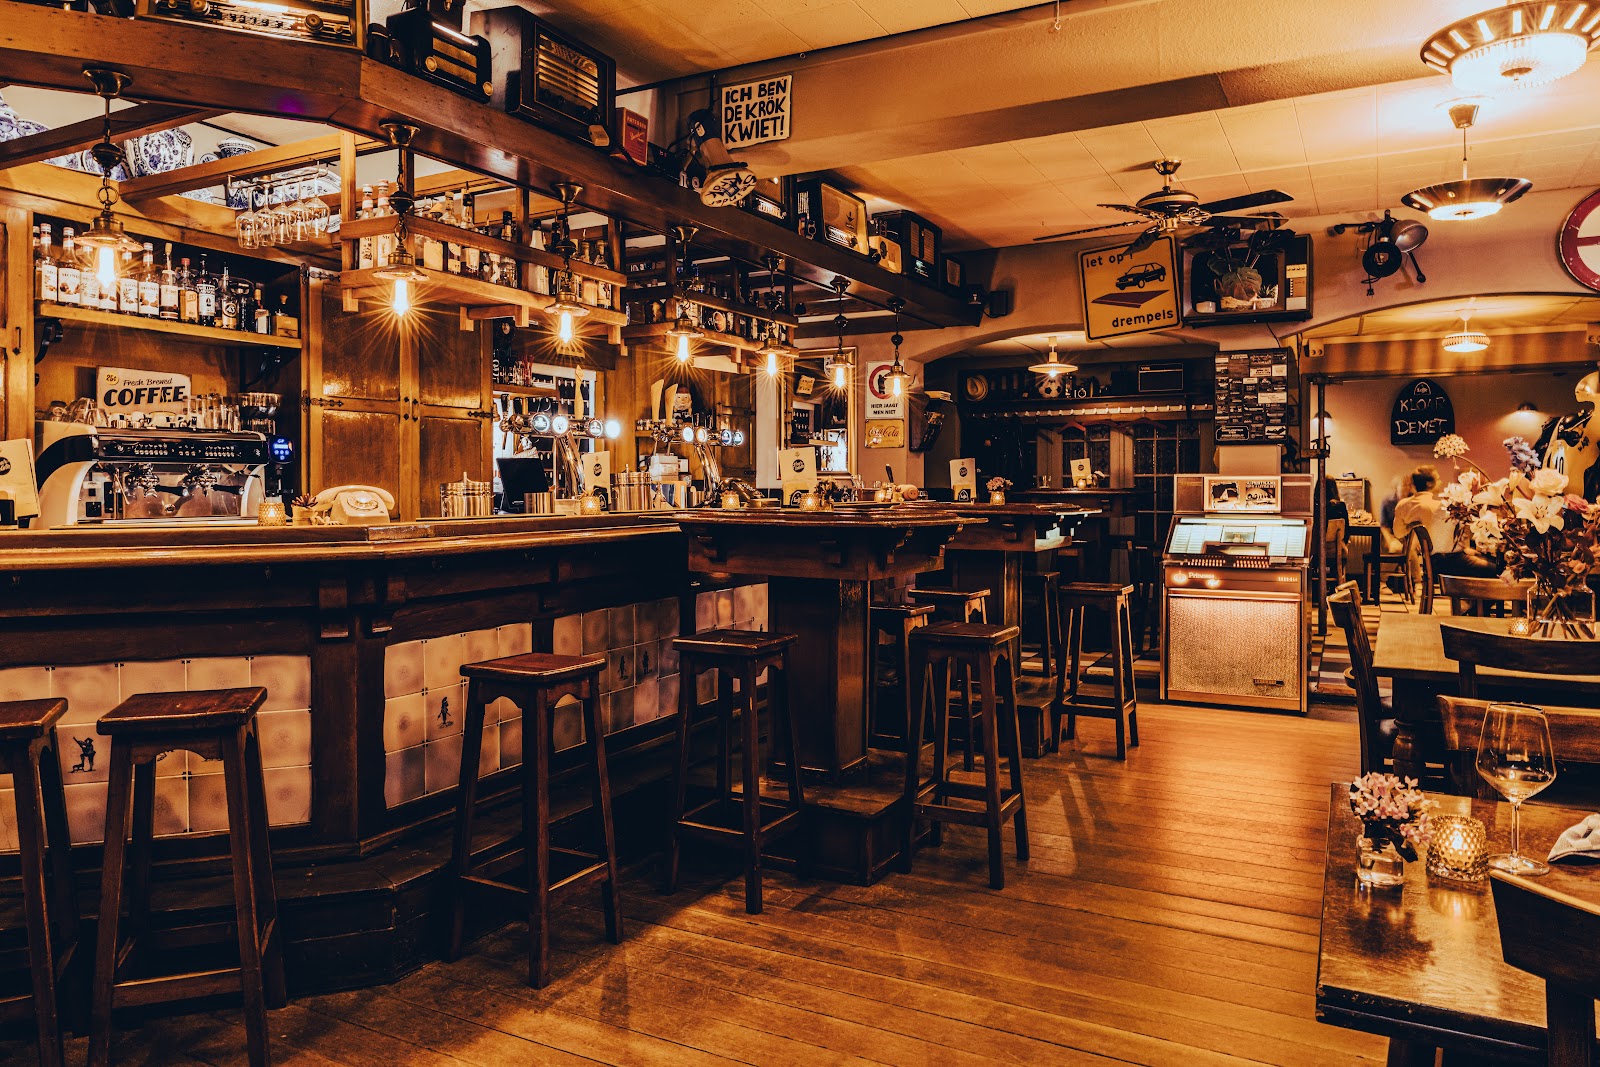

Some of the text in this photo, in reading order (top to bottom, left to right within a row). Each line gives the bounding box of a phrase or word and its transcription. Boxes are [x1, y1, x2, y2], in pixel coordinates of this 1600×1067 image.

[725, 78, 788, 105] ICH BEN
[724, 96, 787, 124] DE KRÖK
[724, 114, 785, 144] KWIET!
[1085, 255, 1103, 268] let
[1108, 253, 1124, 264] op
[1111, 309, 1174, 328] drempels
[123, 377, 173, 387] Fresh Brewed
[103, 385, 186, 407] COFFEE
